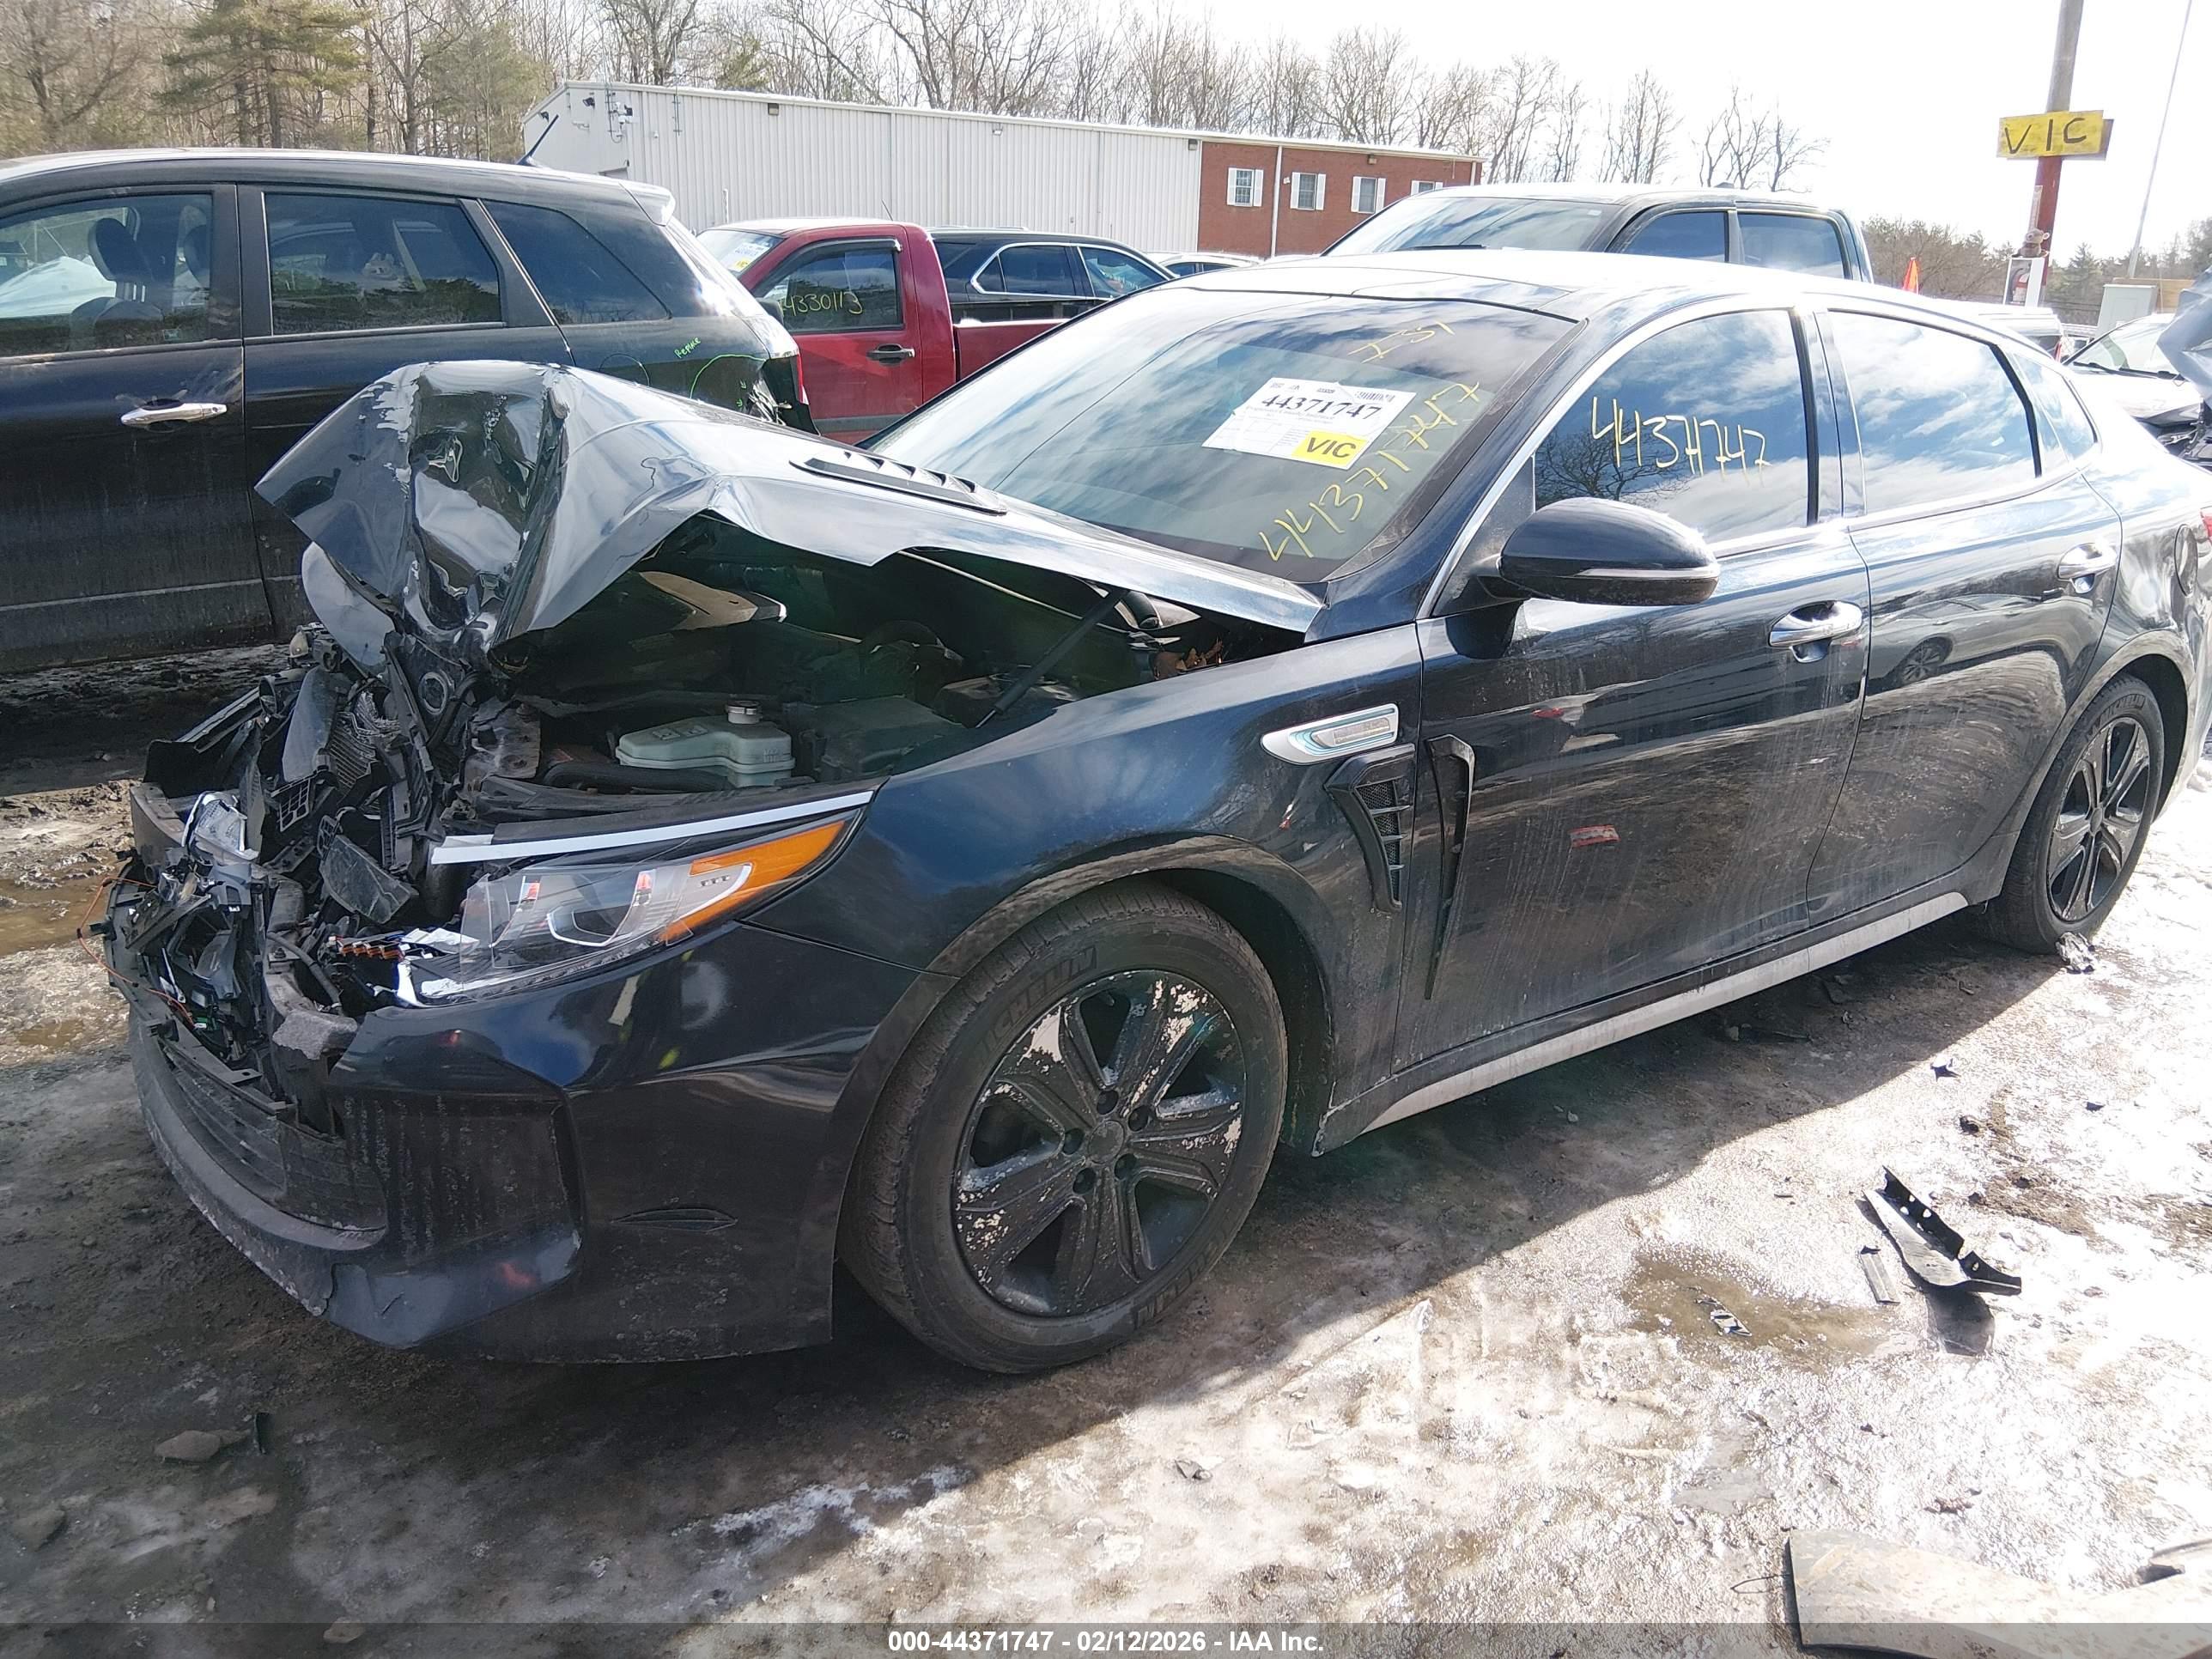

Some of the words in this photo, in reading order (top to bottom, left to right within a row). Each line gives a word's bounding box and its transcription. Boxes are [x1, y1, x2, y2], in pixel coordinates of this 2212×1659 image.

[2004, 117, 2087, 155] VIC
[1261, 394, 1382, 420] 44371747
[1258, 381, 1480, 561] 44371747
[1305, 436, 1357, 459] VIC
[1592, 396, 1773, 487] 44371747
[975, 945, 1097, 1056] ICHELIN
